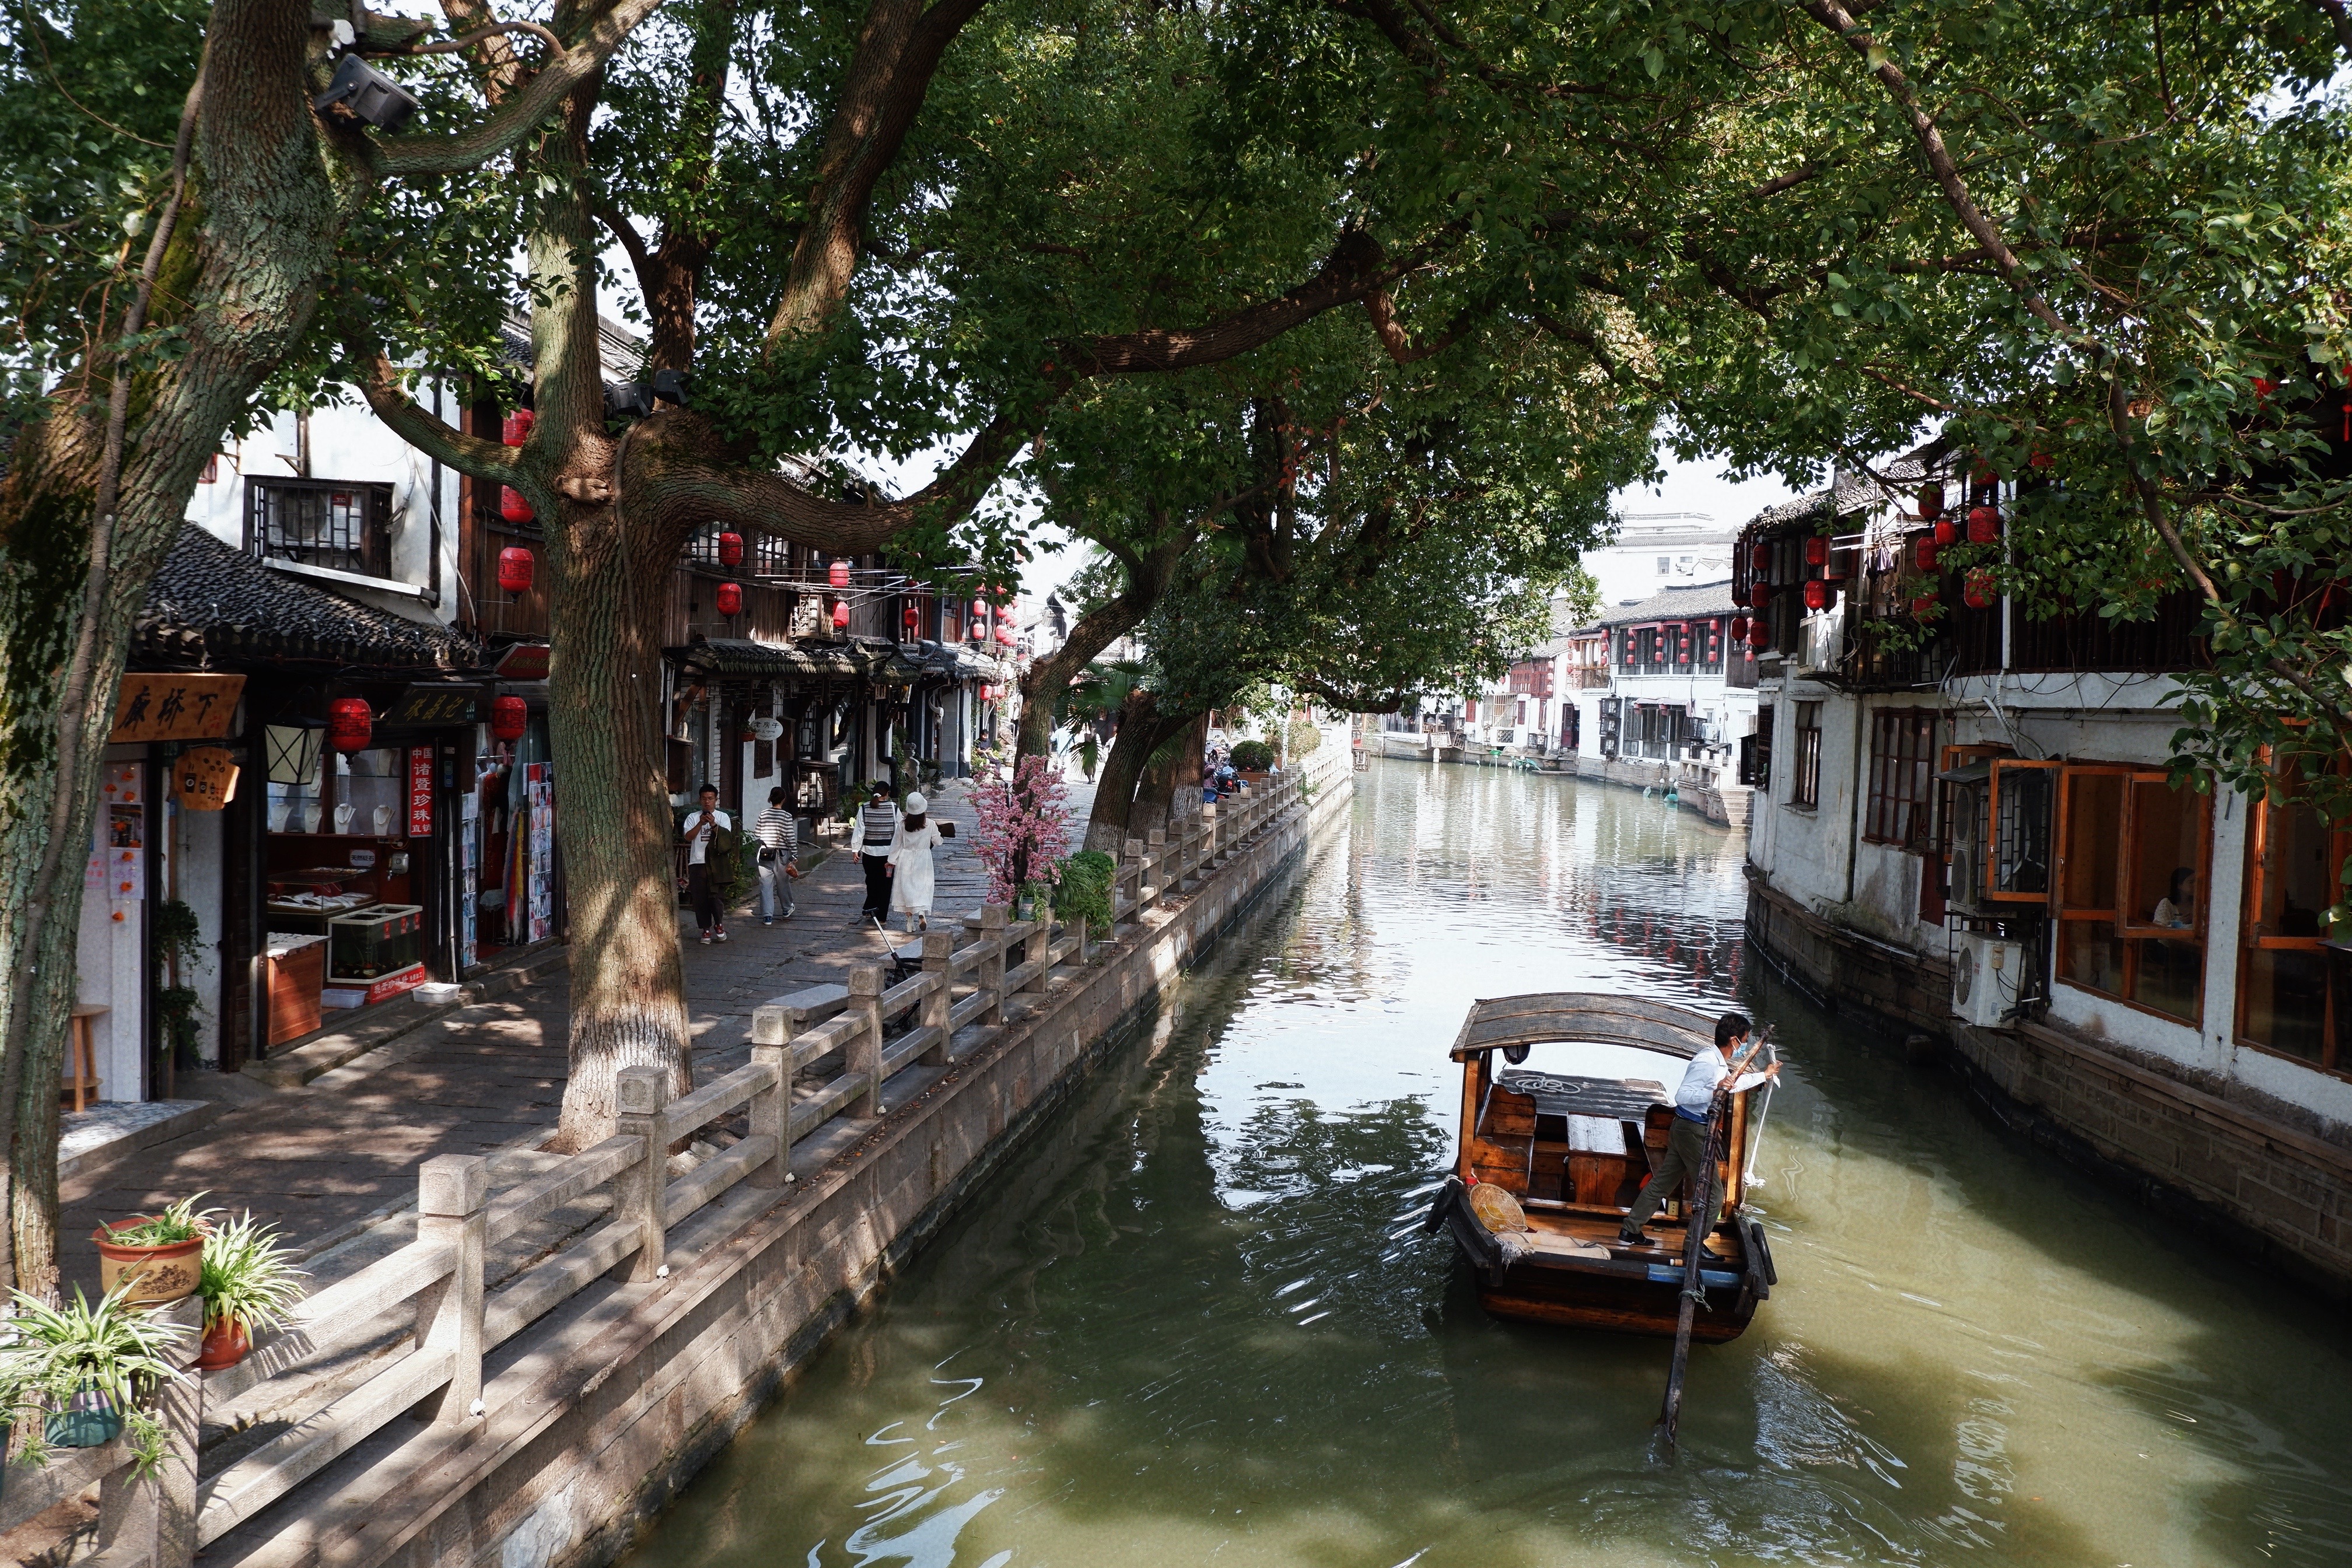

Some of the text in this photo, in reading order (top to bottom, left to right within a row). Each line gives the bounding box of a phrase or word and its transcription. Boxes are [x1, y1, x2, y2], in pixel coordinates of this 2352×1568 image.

[412, 748, 433, 759] 中国
[414, 762, 432, 822] 诸暨珍珠
[411, 824, 432, 833] 直销
